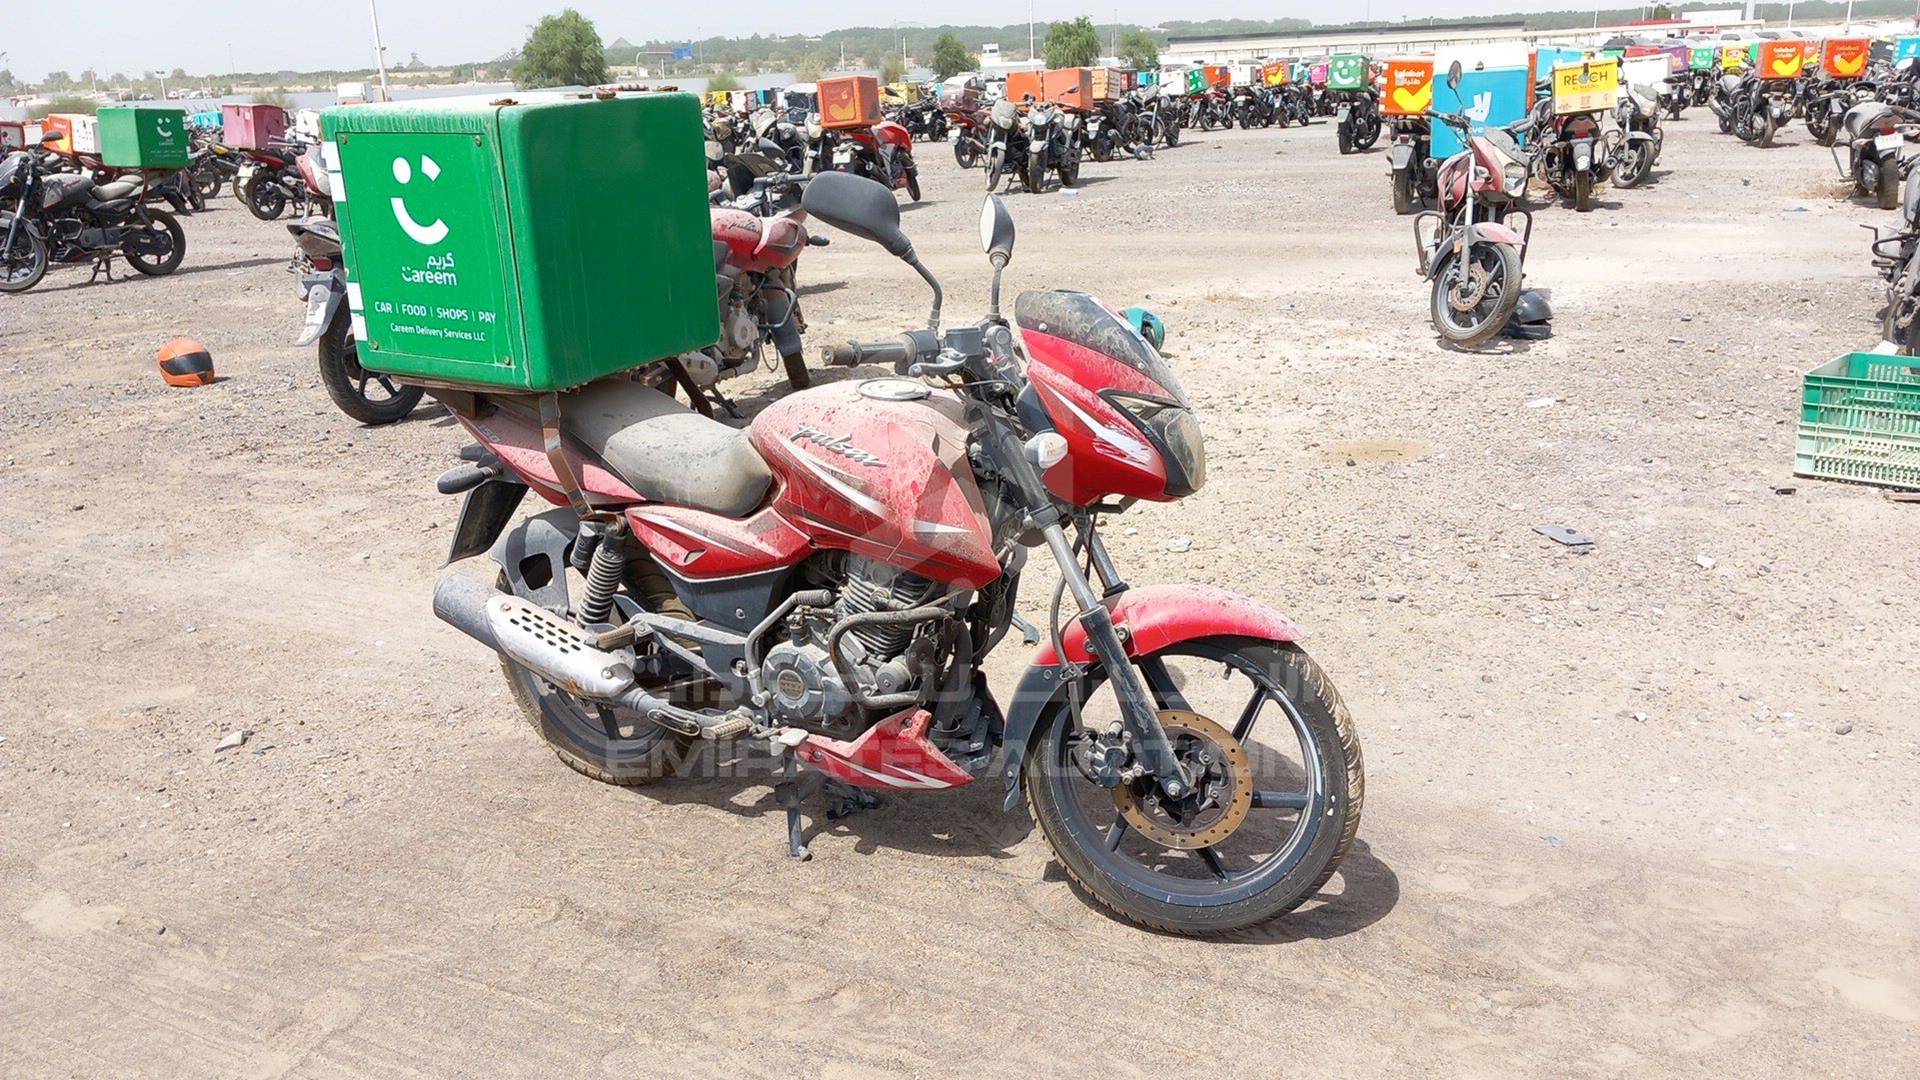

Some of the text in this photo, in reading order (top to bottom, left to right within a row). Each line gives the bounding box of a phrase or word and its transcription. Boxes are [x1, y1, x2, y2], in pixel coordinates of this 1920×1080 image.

[1563, 71, 1608, 86] RECH
[426, 252, 455, 271] كريم
[401, 265, 458, 286] Careem
[374, 301, 496, 325] CAR FOOD SHOPS PAY
[390, 322, 486, 342] Careem Delivery Services LLC
[789, 424, 888, 468] pulsar
